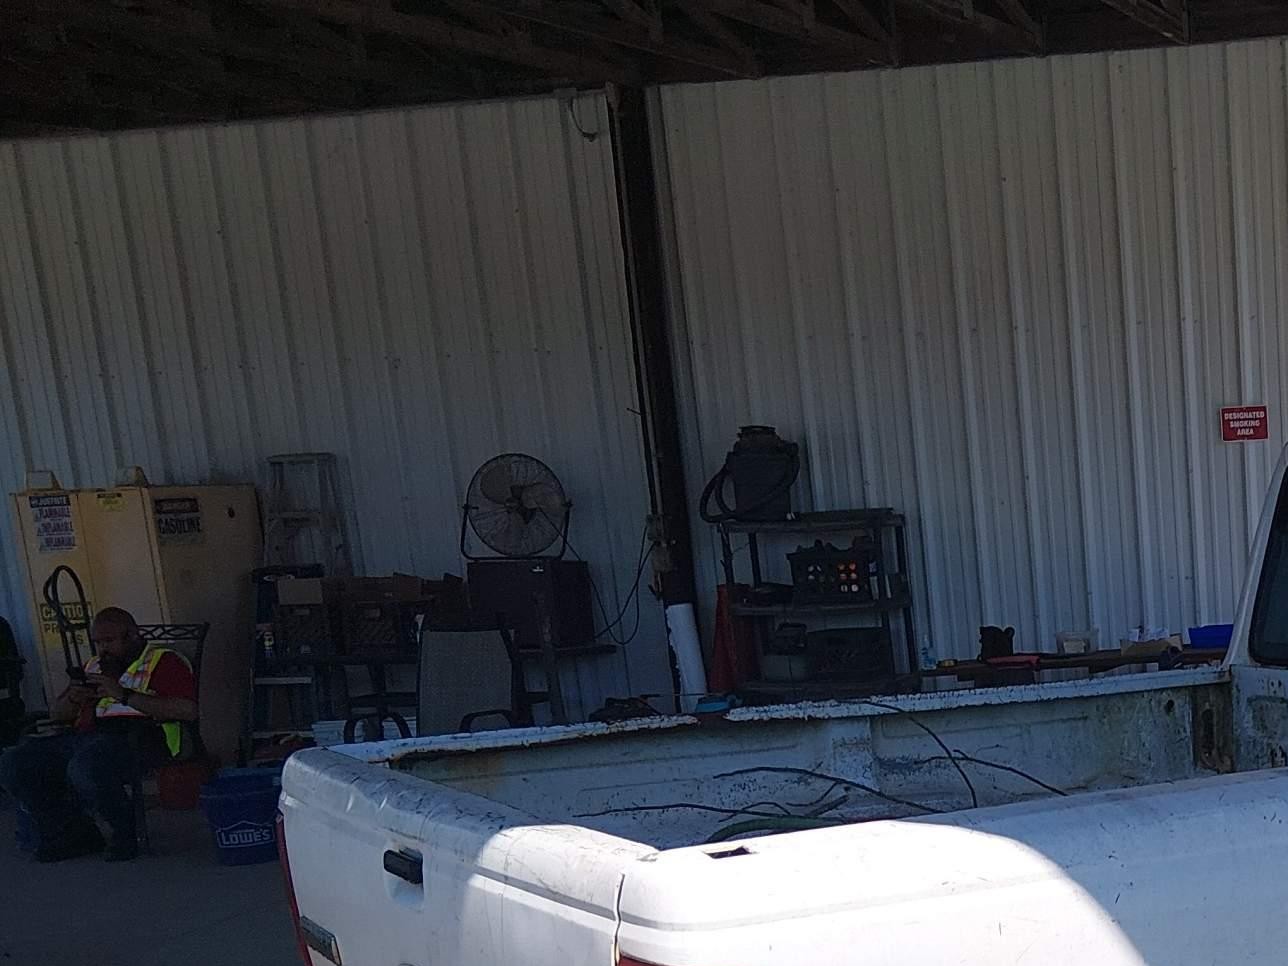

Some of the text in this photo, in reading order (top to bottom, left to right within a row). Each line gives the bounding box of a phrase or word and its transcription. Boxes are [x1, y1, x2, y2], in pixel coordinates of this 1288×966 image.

[1224, 411, 1265, 420] DESIGNATED
[1229, 419, 1261, 428] SMOKING
[1236, 428, 1254, 436] AREA
[221, 828, 271, 845] LOWE'S
